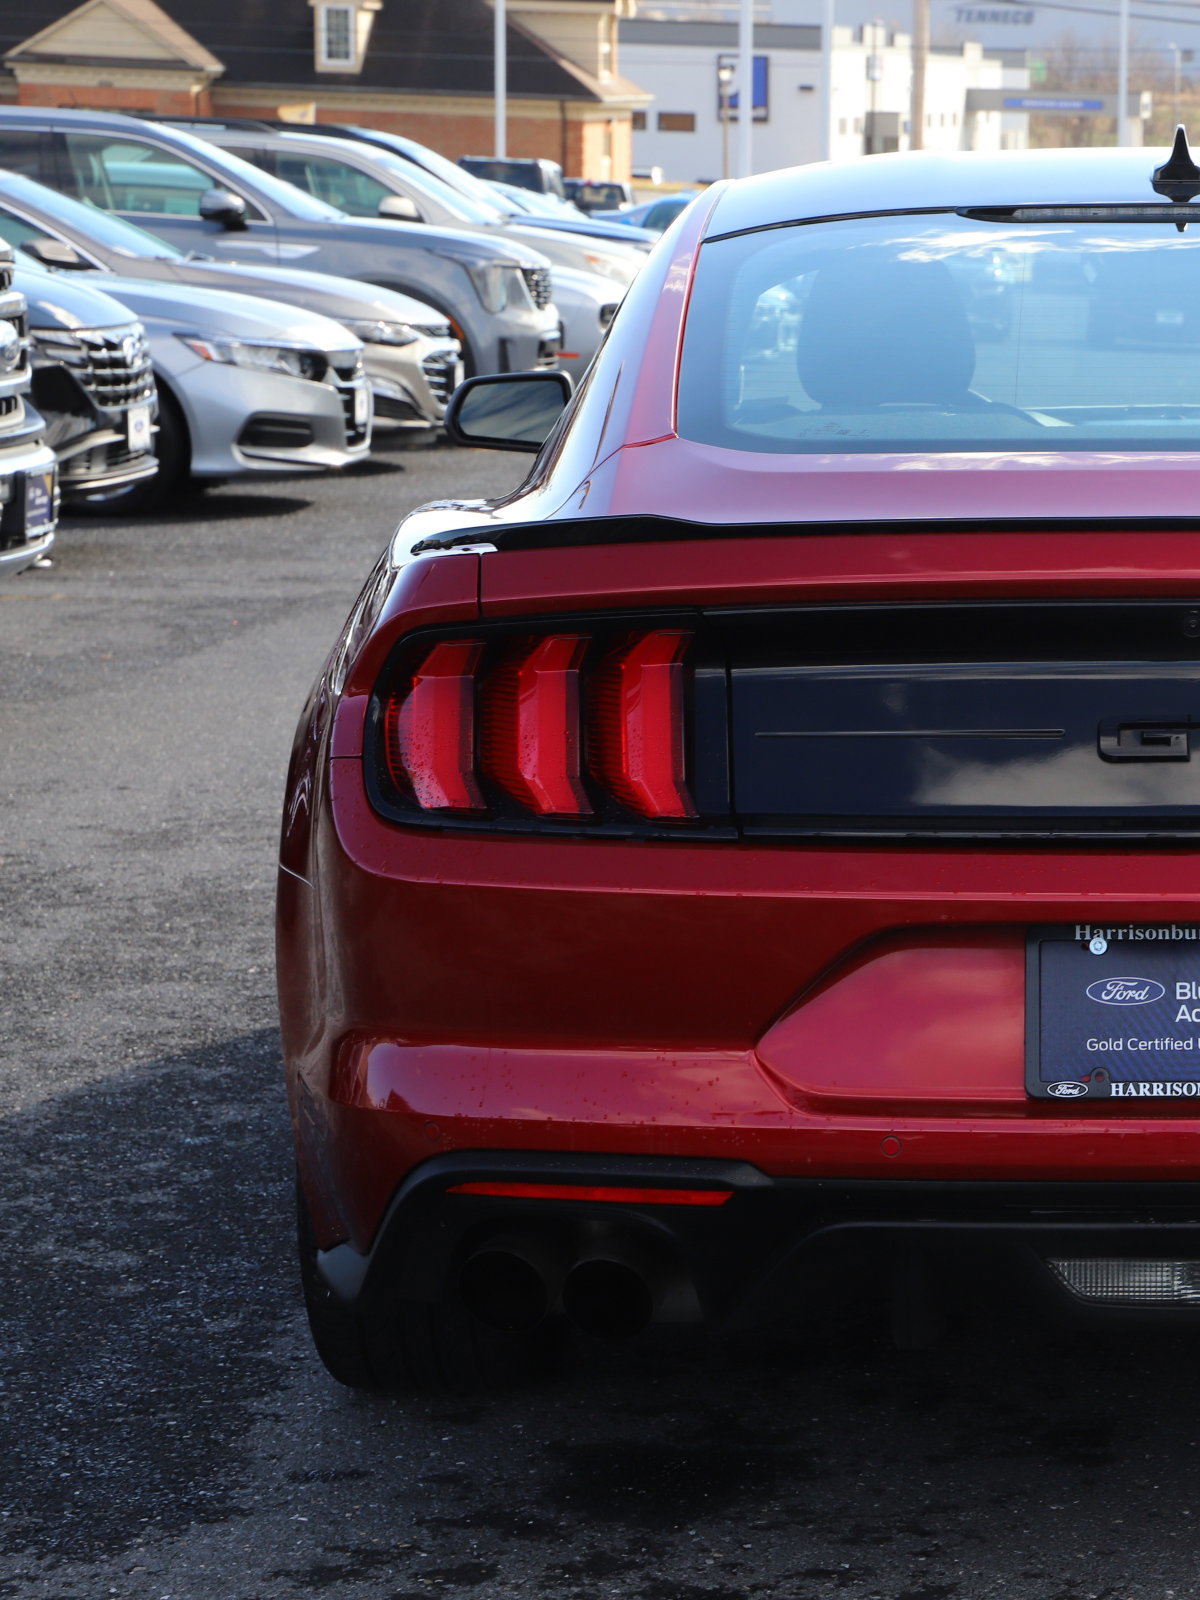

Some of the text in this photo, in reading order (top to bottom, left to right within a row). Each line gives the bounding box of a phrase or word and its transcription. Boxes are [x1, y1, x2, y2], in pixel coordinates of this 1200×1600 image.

[1101, 980, 1149, 1001] Ford
[1086, 1038, 1123, 1051] Gold
[1127, 1037, 1193, 1051] Certified
